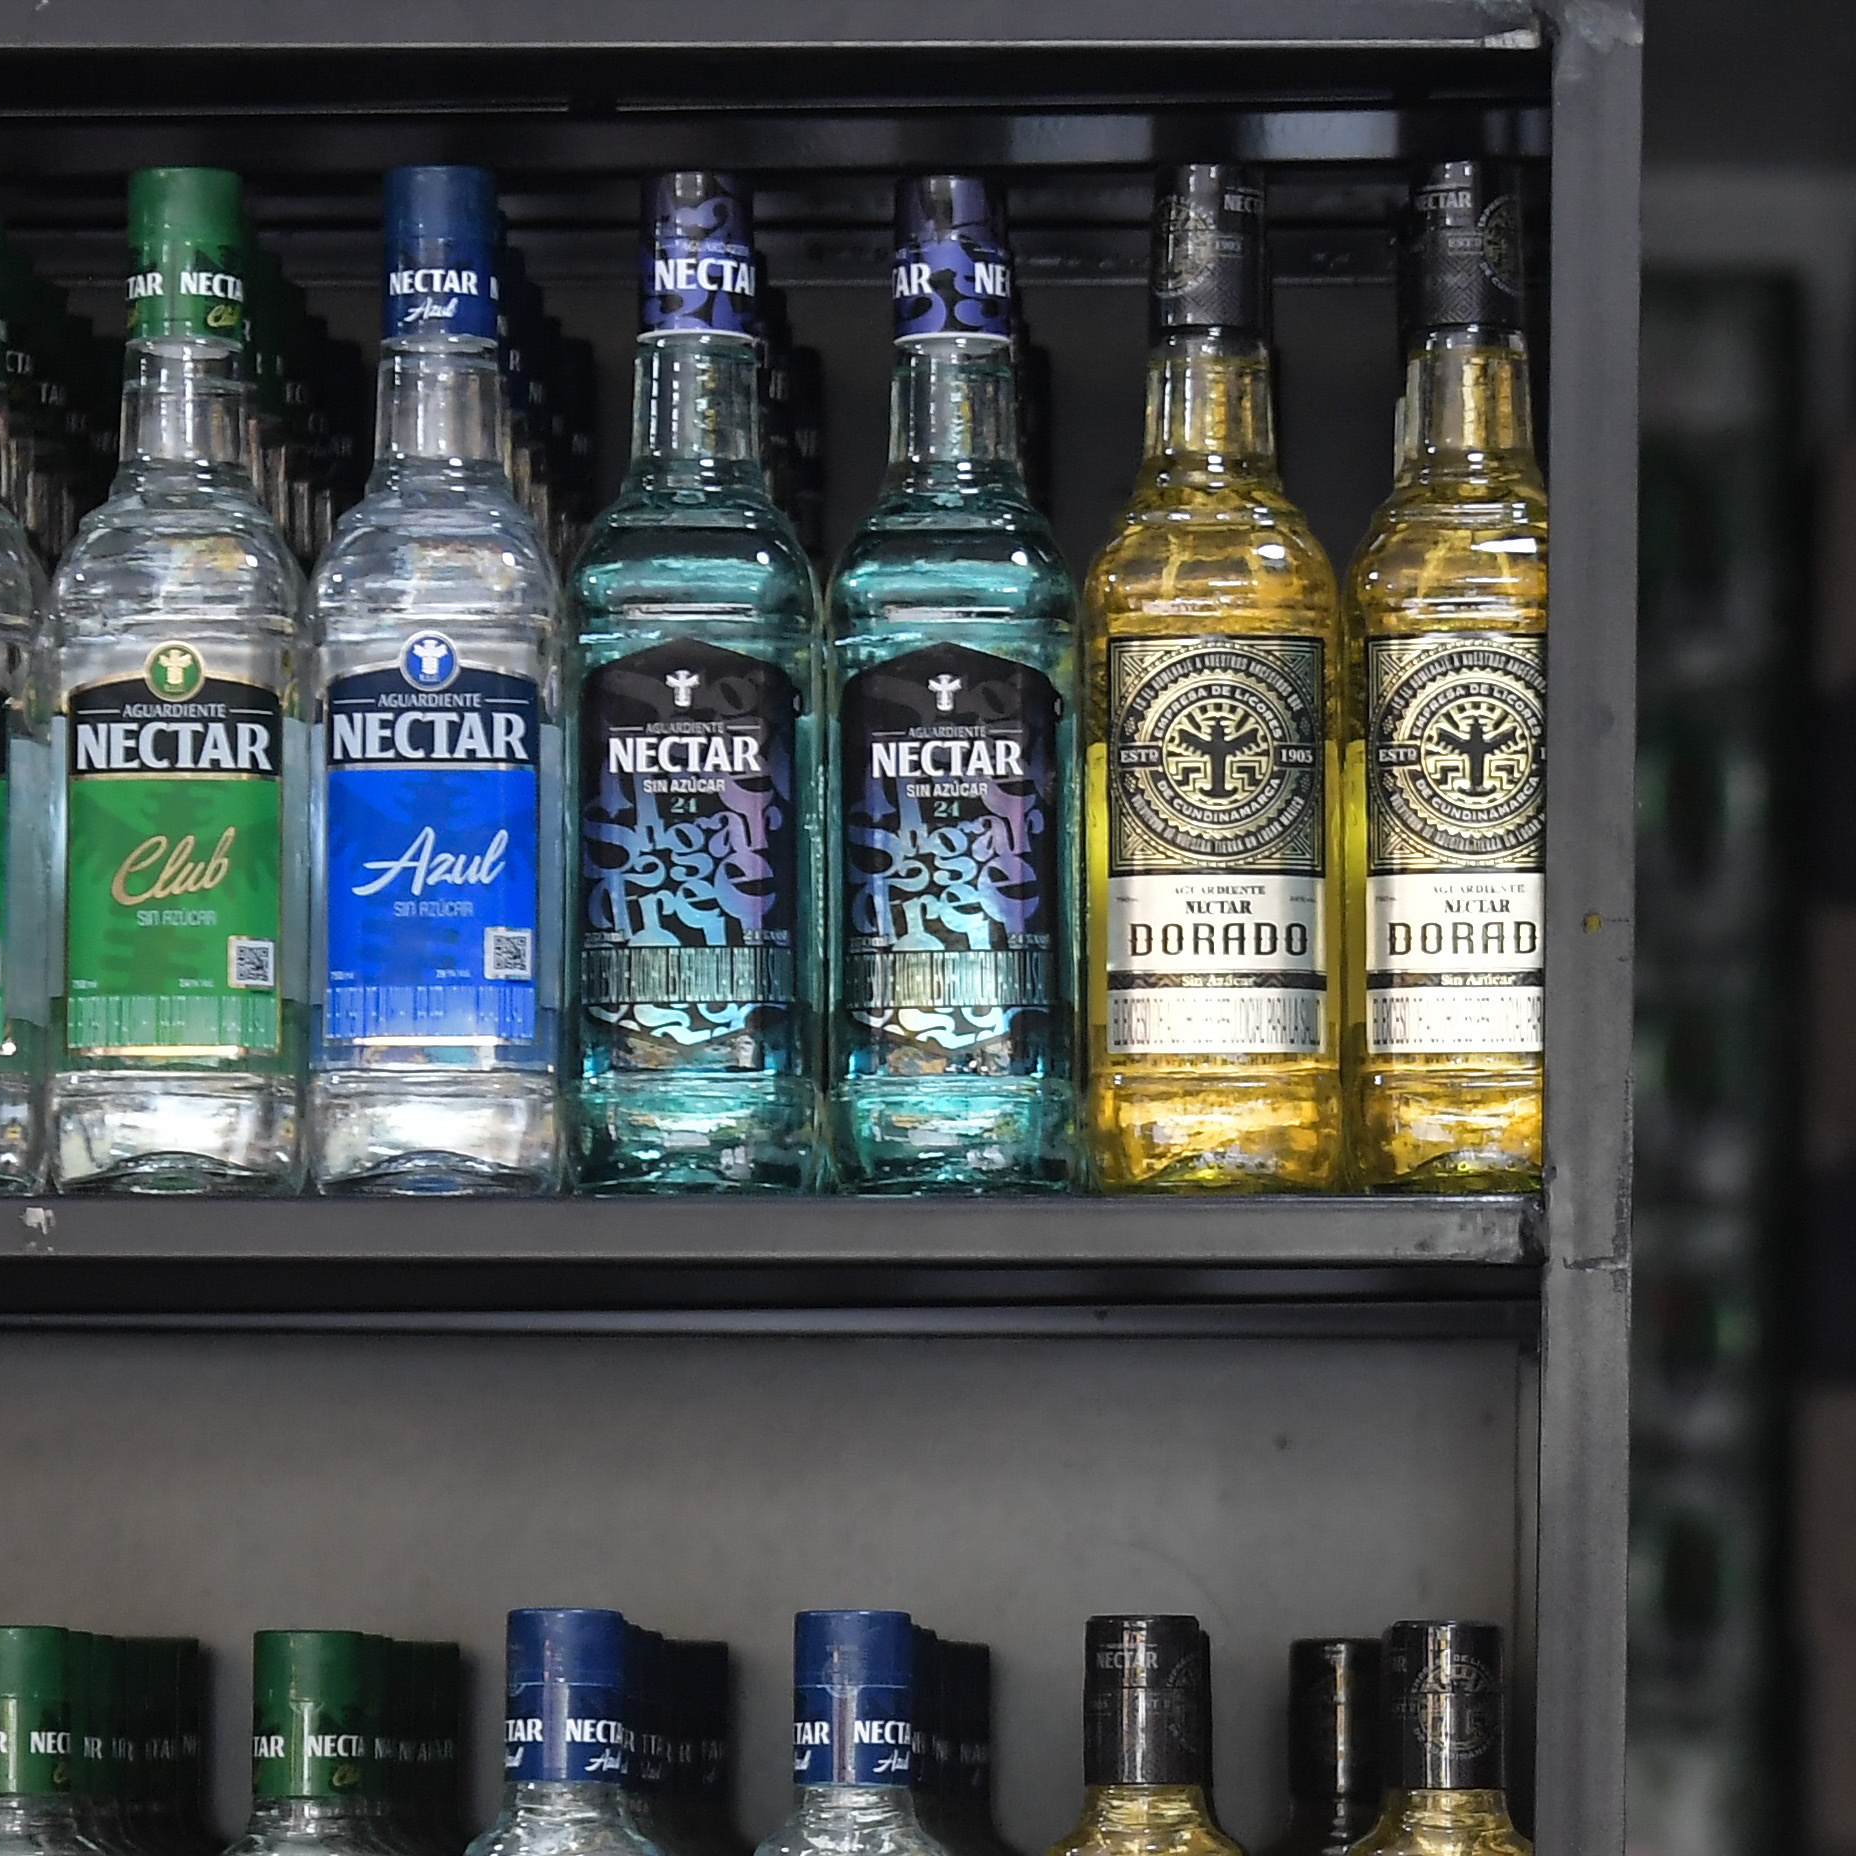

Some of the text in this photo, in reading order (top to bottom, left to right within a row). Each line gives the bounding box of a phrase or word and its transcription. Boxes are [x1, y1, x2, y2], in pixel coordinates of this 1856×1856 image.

[388, 268, 479, 296] NECTAR
[403, 296, 459, 323] Azul
[122, 702, 227, 718] AGUARDIENTE
[377, 692, 483, 709] AGUARDIENTE
[1412, 683, 1542, 737] EMPRESA DE LICORES
[1153, 685, 1283, 739] EMPRESA DE LICORES
[332, 711, 528, 761] NECTAR
[645, 721, 725, 735] AGUARDIENTE
[907, 725, 987, 738] AGUARDIENTE
[75, 722, 273, 771] NECTAR
[609, 734, 761, 774] NECTAR
[1280, 749, 1314, 763] 1905
[871, 739, 1024, 779] NECTAR
[642, 775, 726, 794] SIN AZÚCAR
[906, 778, 989, 798] SIN AZÚCAR
[1156, 777, 1281, 822] DE CUNDINAMARCA
[1415, 776, 1540, 821] DE CUNDINAMARCA
[110, 825, 236, 907] Club
[351, 825, 510, 897] Azul
[1174, 885, 1266, 896] AGUARDIENTE
[393, 900, 417, 918] SIN
[1185, 900, 1253, 915] NECTAR
[1443, 899, 1511, 915] NECTAR
[136, 909, 161, 927] SIN
[1128, 921, 1309, 957] DORADO
[1387, 920, 1538, 956] DORAD
[1181, 973, 1203, 987] Sin
[1440, 973, 1463, 987] Sin
[1096, 1649, 1160, 1670] NECTAR
